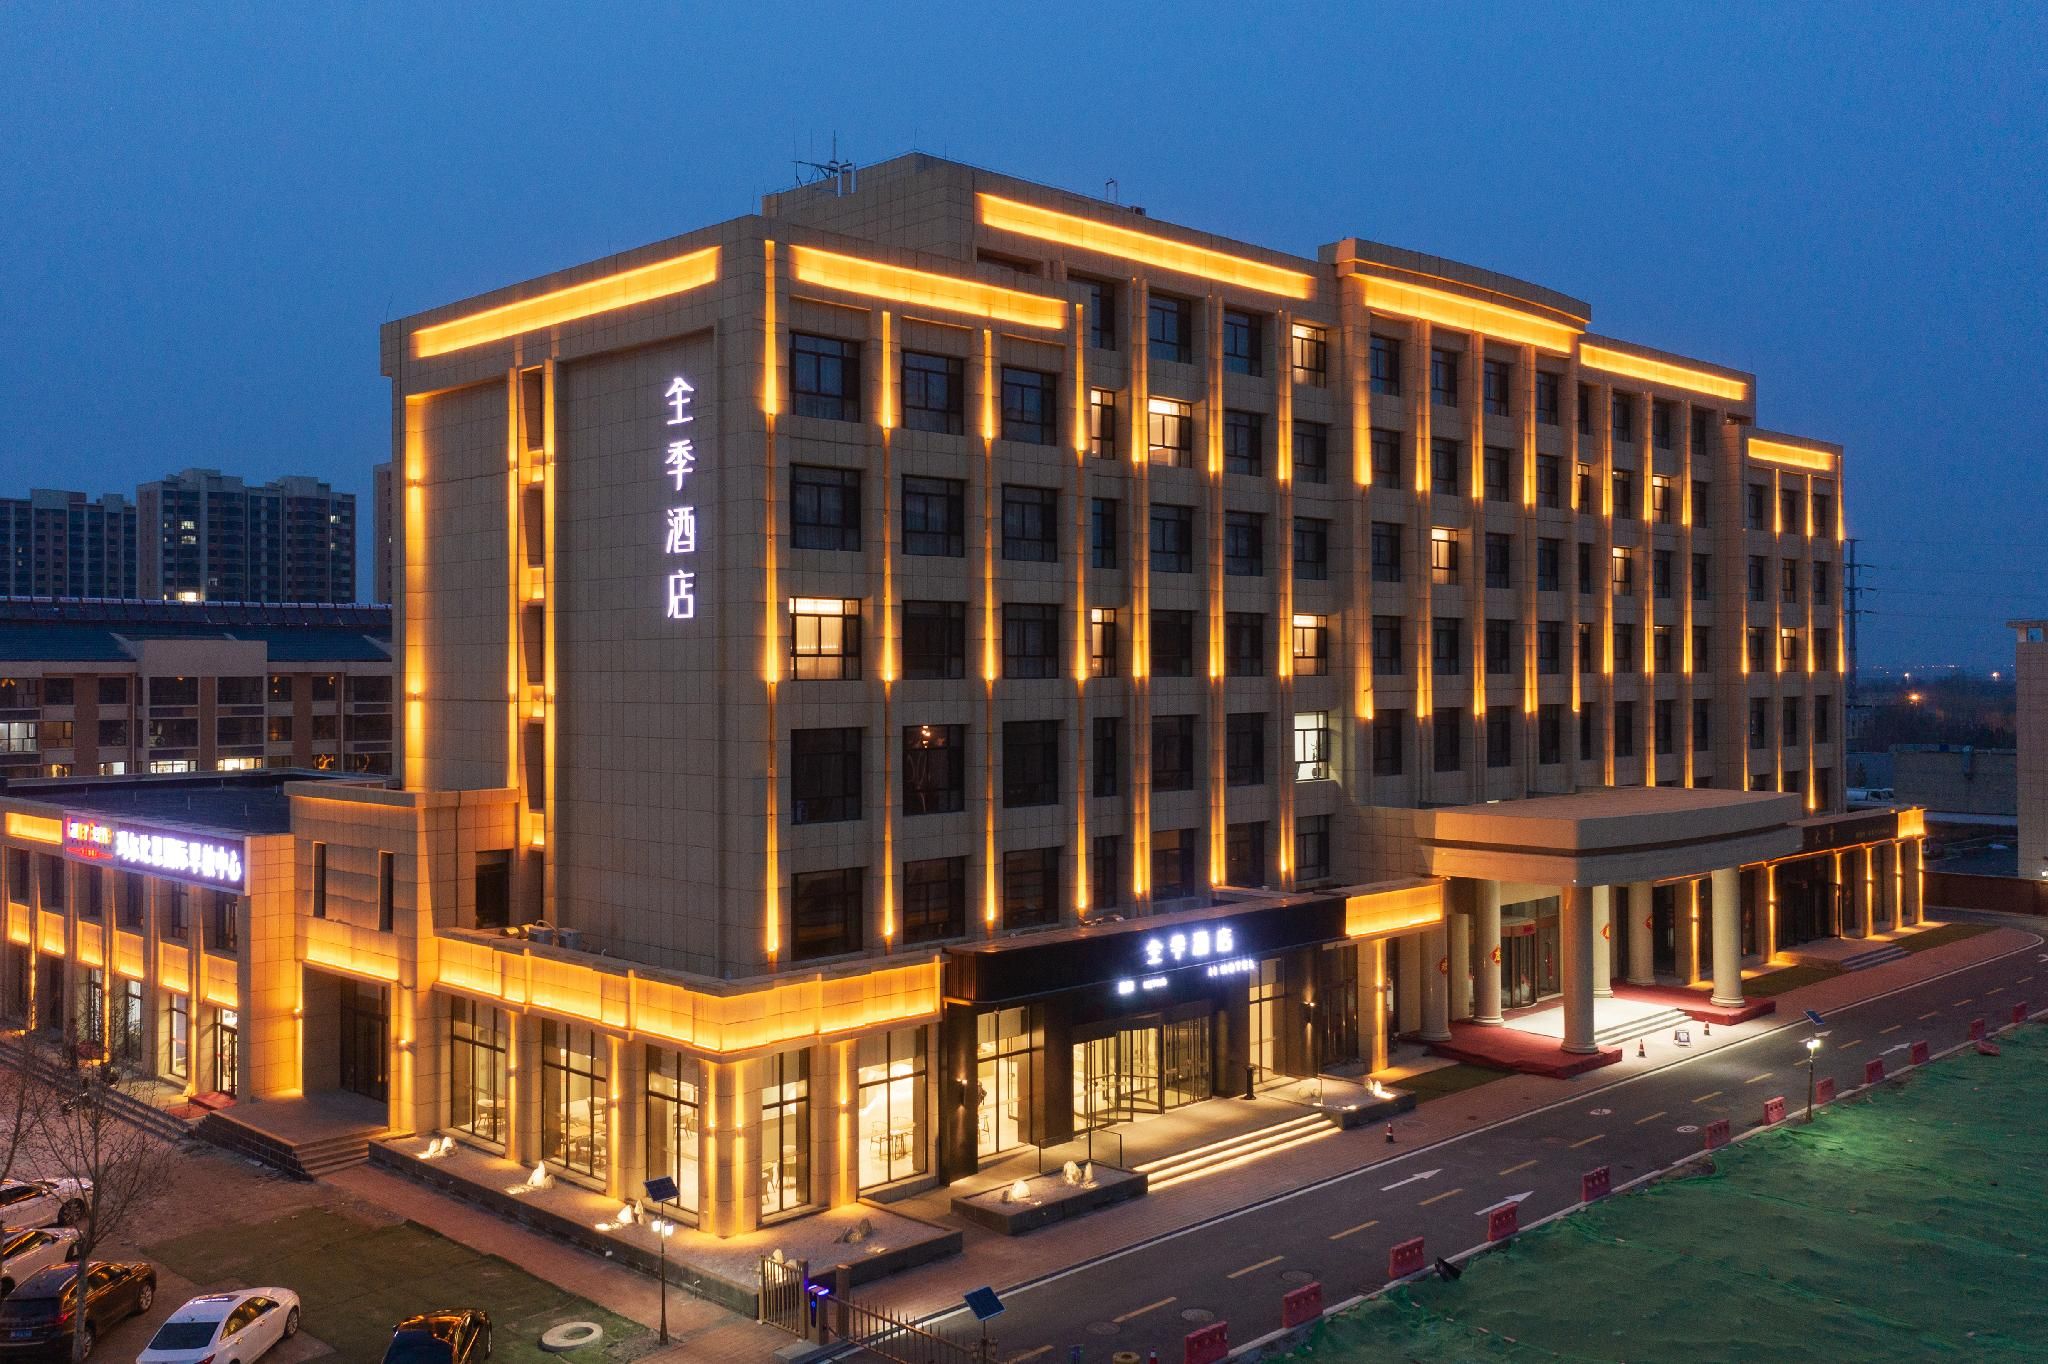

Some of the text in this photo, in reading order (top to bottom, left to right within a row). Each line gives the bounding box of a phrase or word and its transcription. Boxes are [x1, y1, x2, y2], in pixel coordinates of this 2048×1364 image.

[664, 377, 696, 620] 全季酒店
[1145, 927, 1234, 965] 全季酒店
